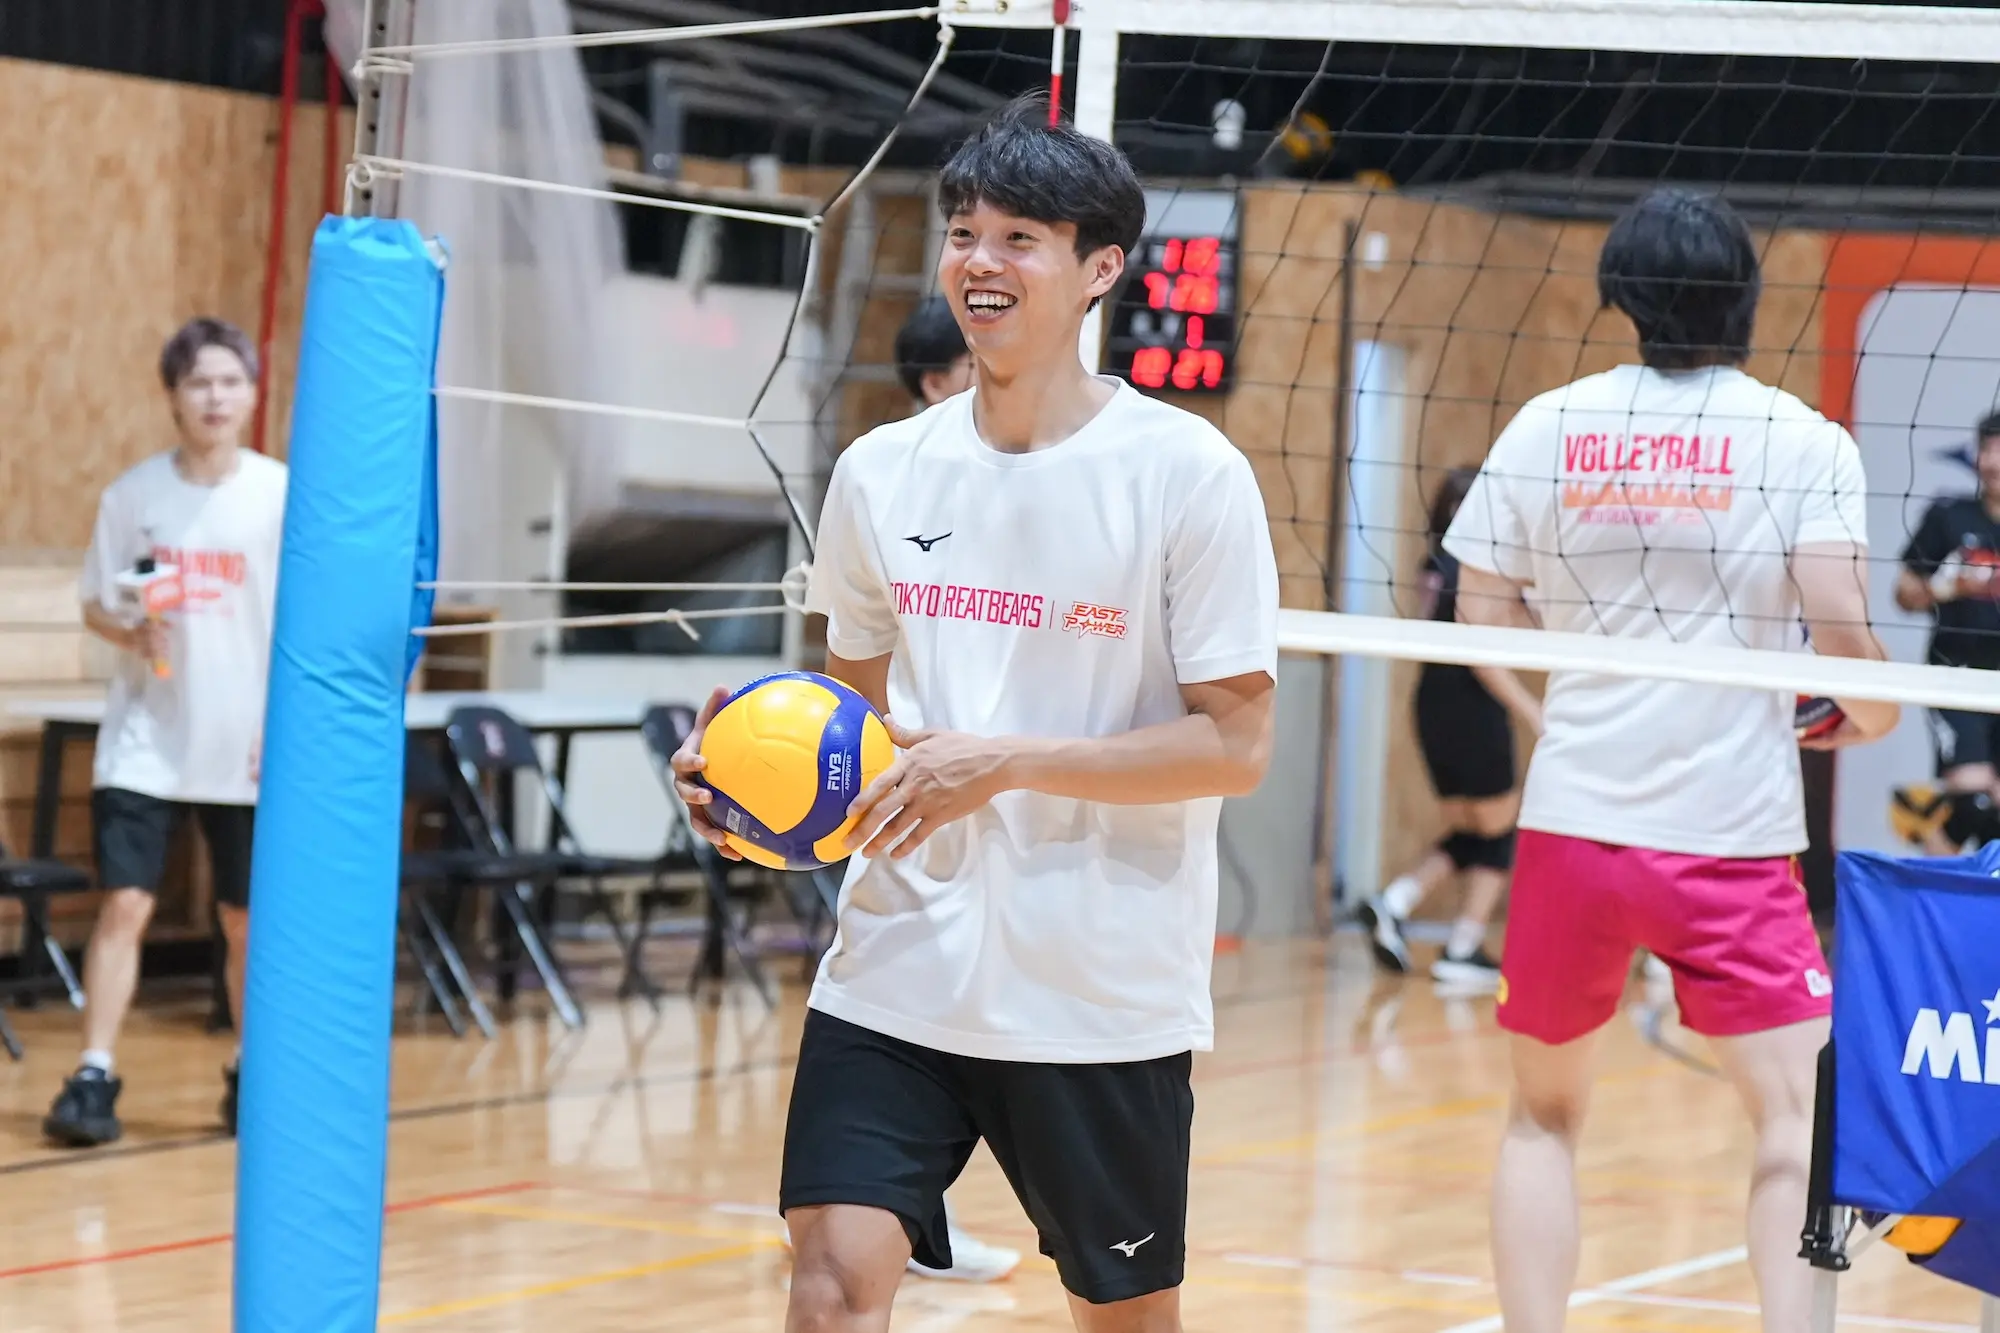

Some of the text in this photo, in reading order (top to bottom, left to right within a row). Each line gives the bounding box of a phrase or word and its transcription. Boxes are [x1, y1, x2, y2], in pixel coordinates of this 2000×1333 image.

[1565, 434, 1734, 475] VOLLEYBALL
[890, 582, 941, 617] OKYO
[1073, 604, 1124, 621] EAST
